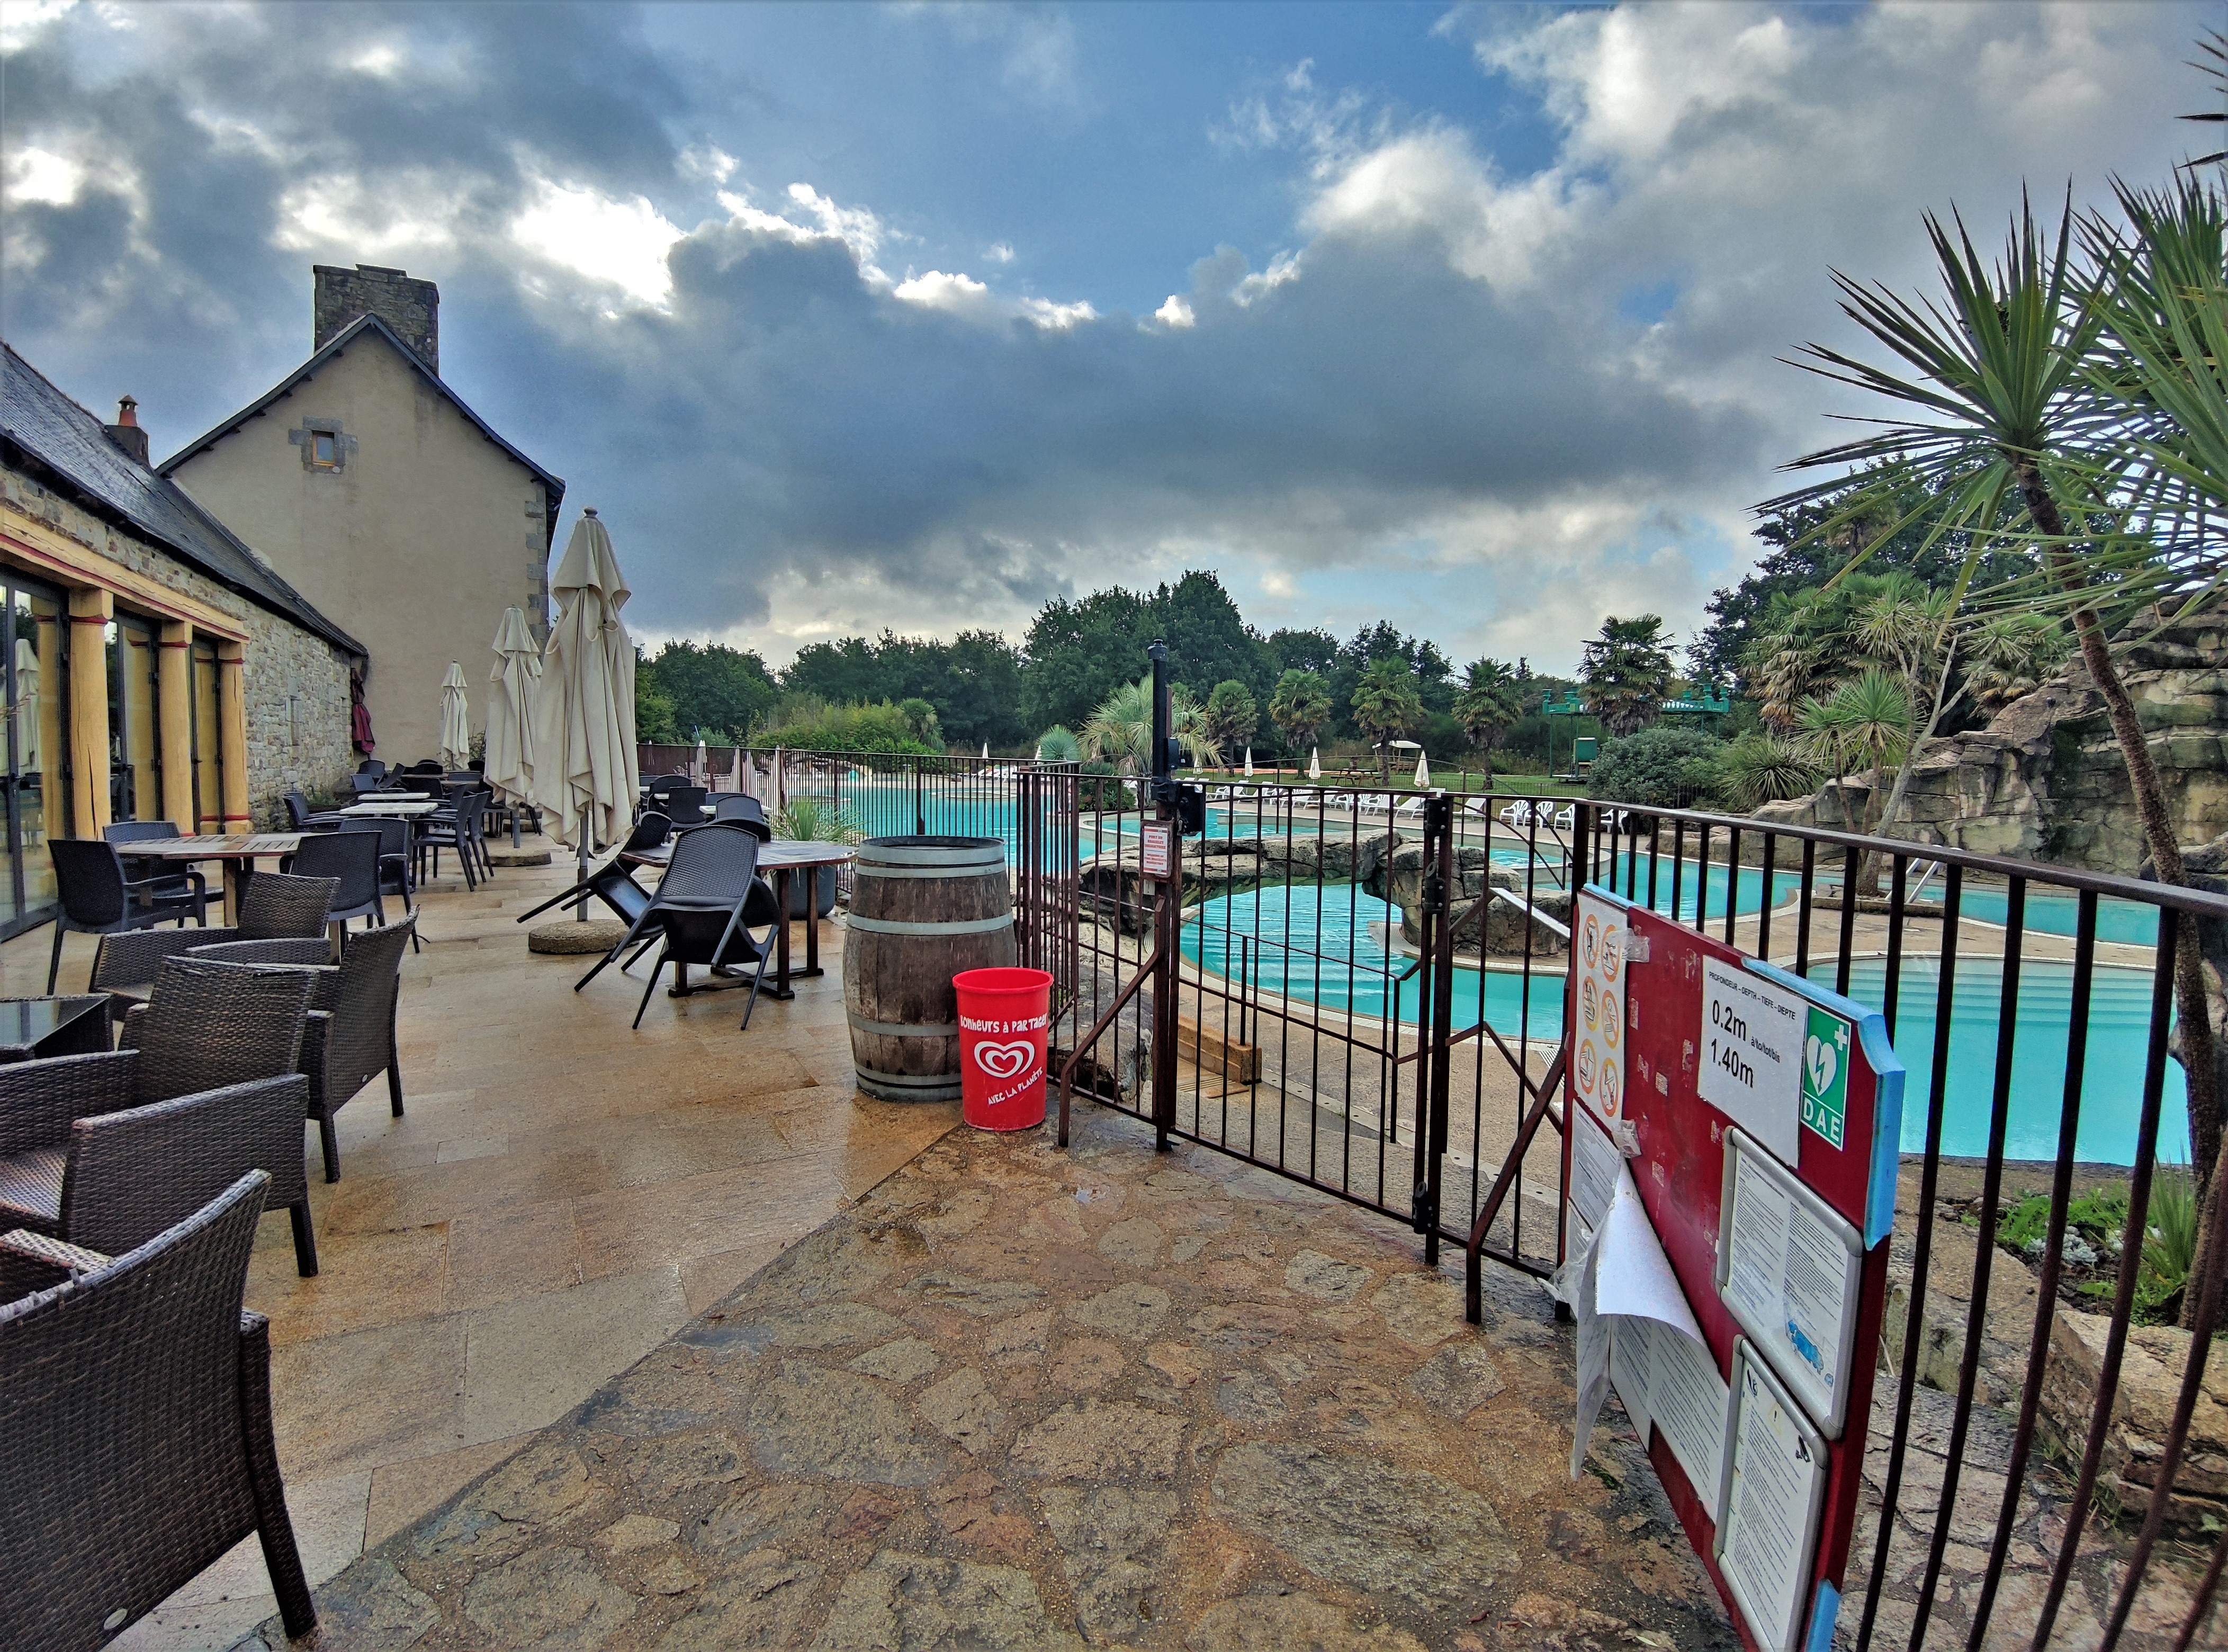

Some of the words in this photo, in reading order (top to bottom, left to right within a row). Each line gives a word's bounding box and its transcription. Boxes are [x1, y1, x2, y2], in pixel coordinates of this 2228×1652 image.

[1709, 971, 1738, 991] PROFONDEUR
[1741, 986, 1757, 1000] DEPTH
[1761, 995, 1774, 1009] TIEFE
[1777, 1004, 1796, 1020] DIEPTE
[1712, 1000, 1746, 1042] 0.2m
[1711, 1038, 1754, 1089] 1.40m
[987, 1092, 1005, 1105] AVEC
[1005, 1087, 1018, 1098] LA
[1803, 1097, 1840, 1142] DAE
